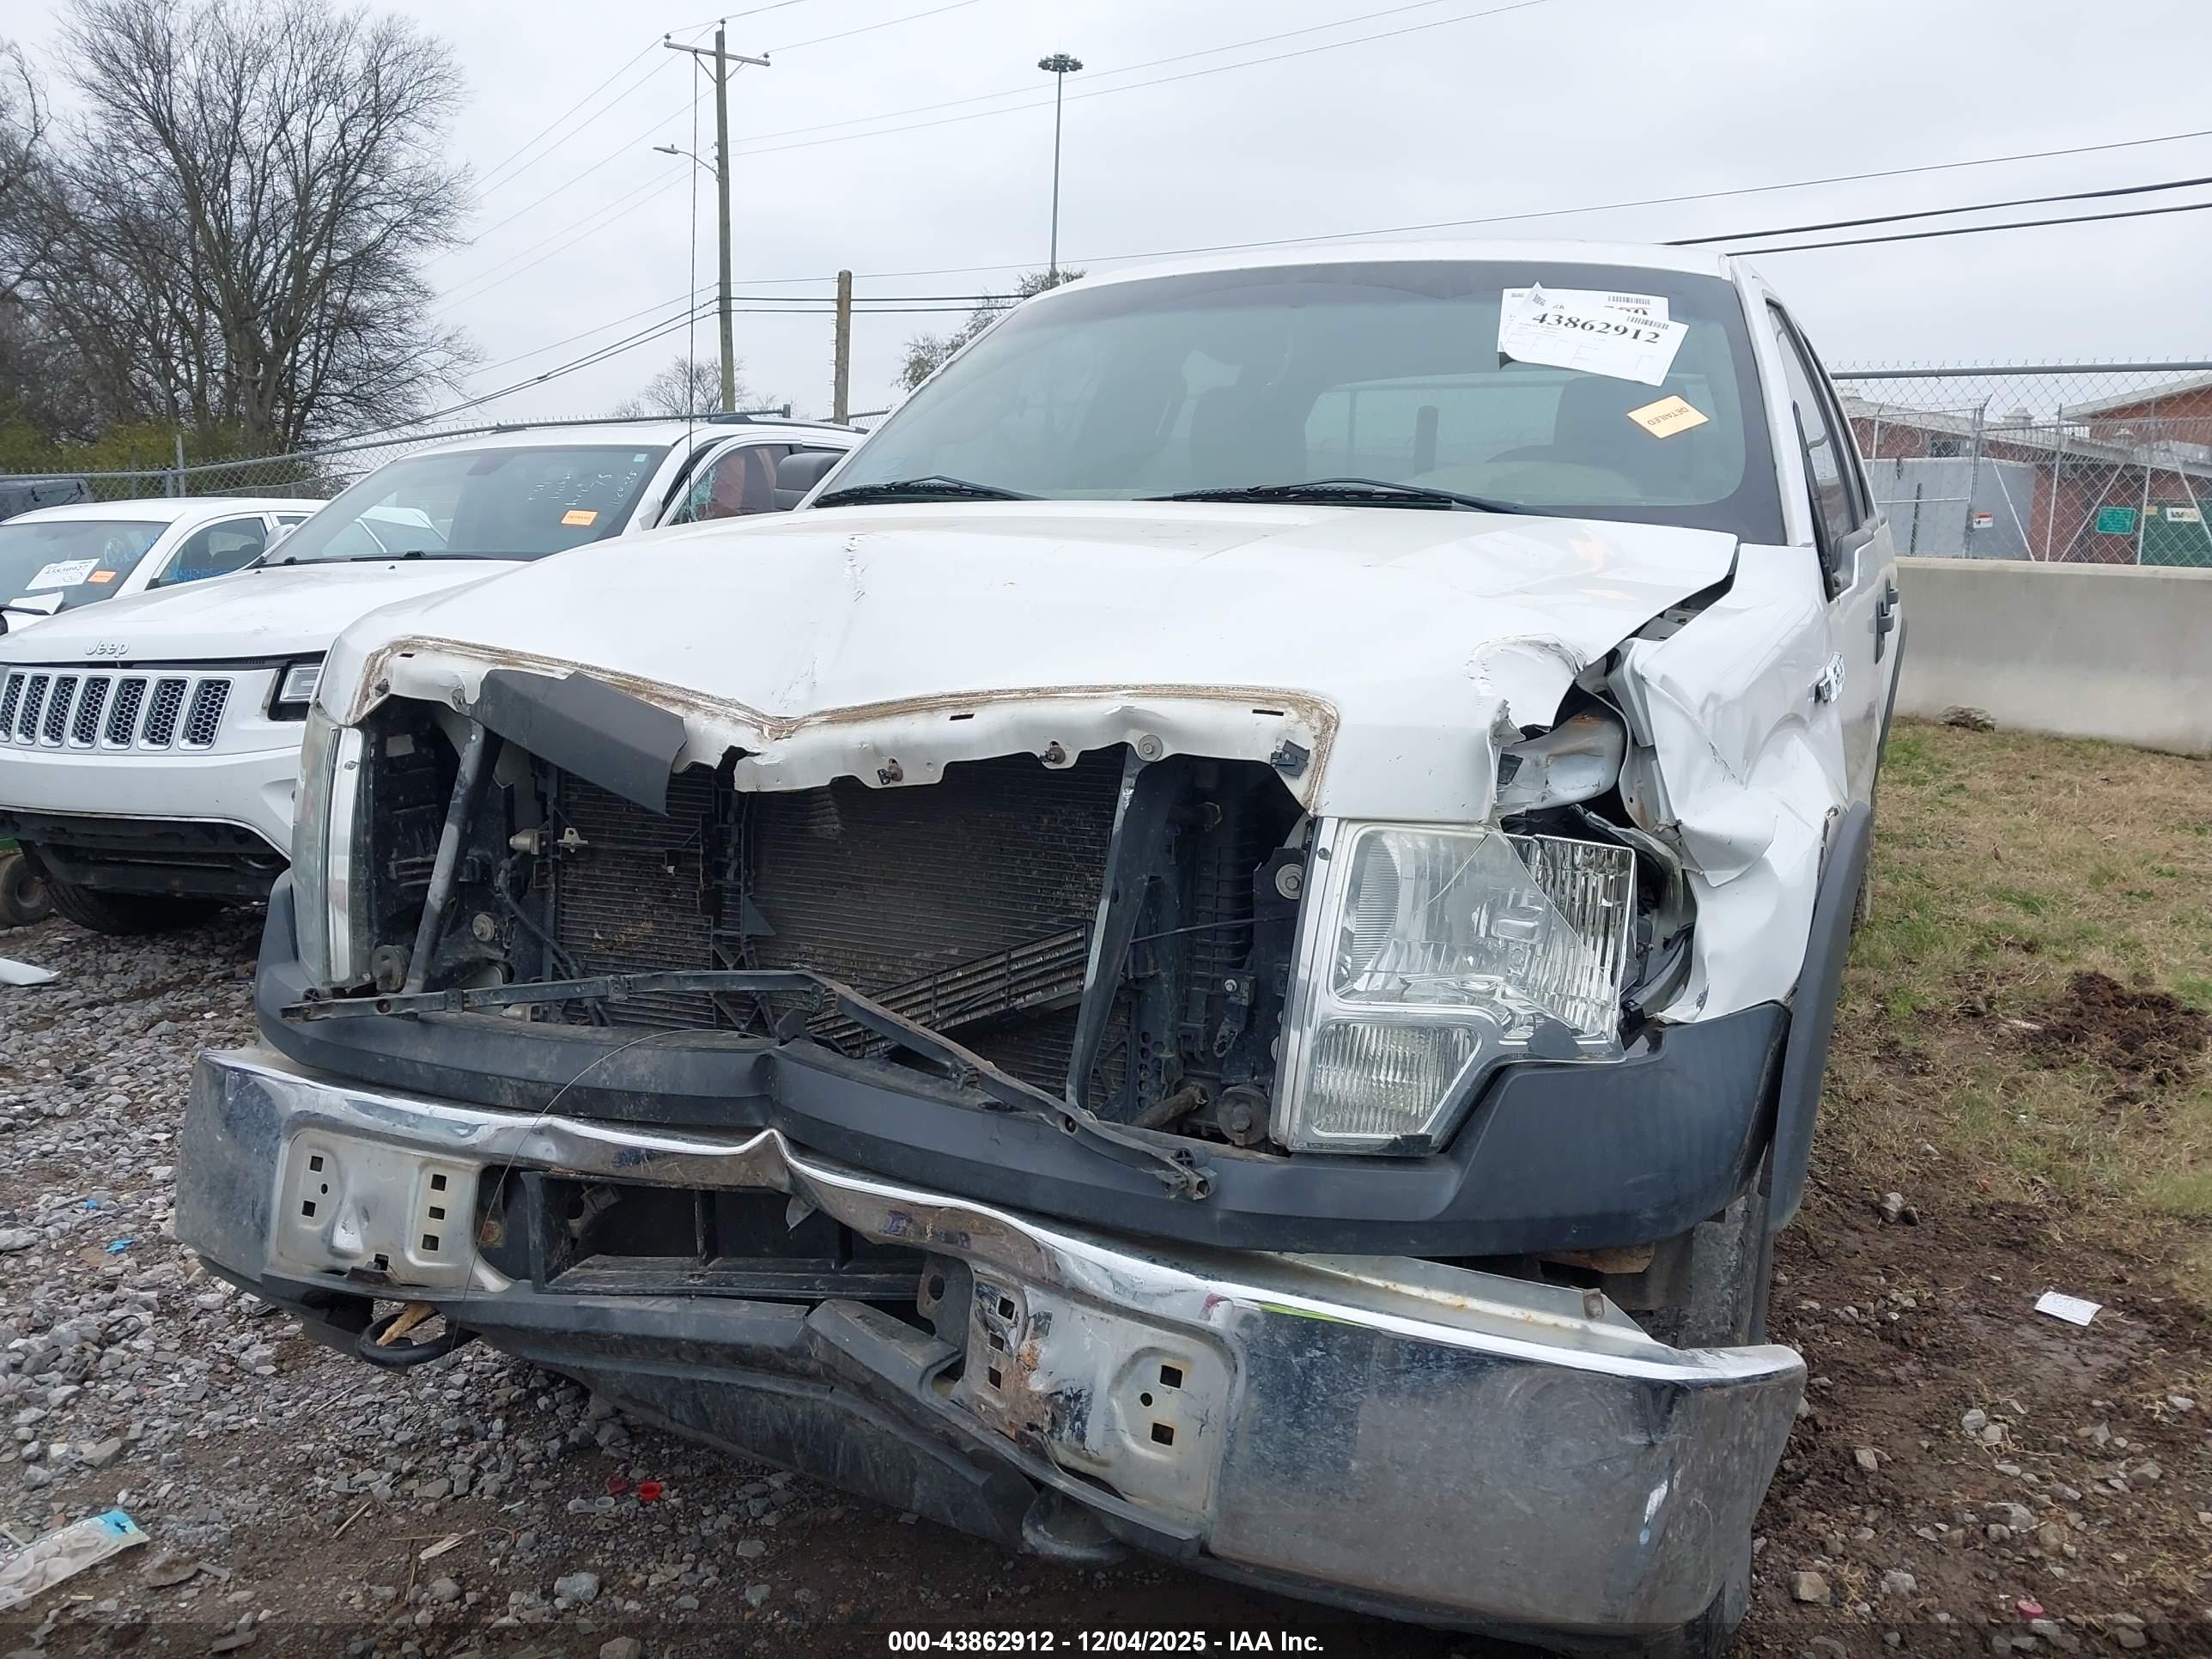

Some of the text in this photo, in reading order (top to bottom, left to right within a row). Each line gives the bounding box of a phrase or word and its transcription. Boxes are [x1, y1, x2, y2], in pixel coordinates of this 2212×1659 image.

[1532, 313, 1661, 344] 43862912
[1647, 406, 1689, 426] DETAILED
[85, 639, 130, 658] Jeep
